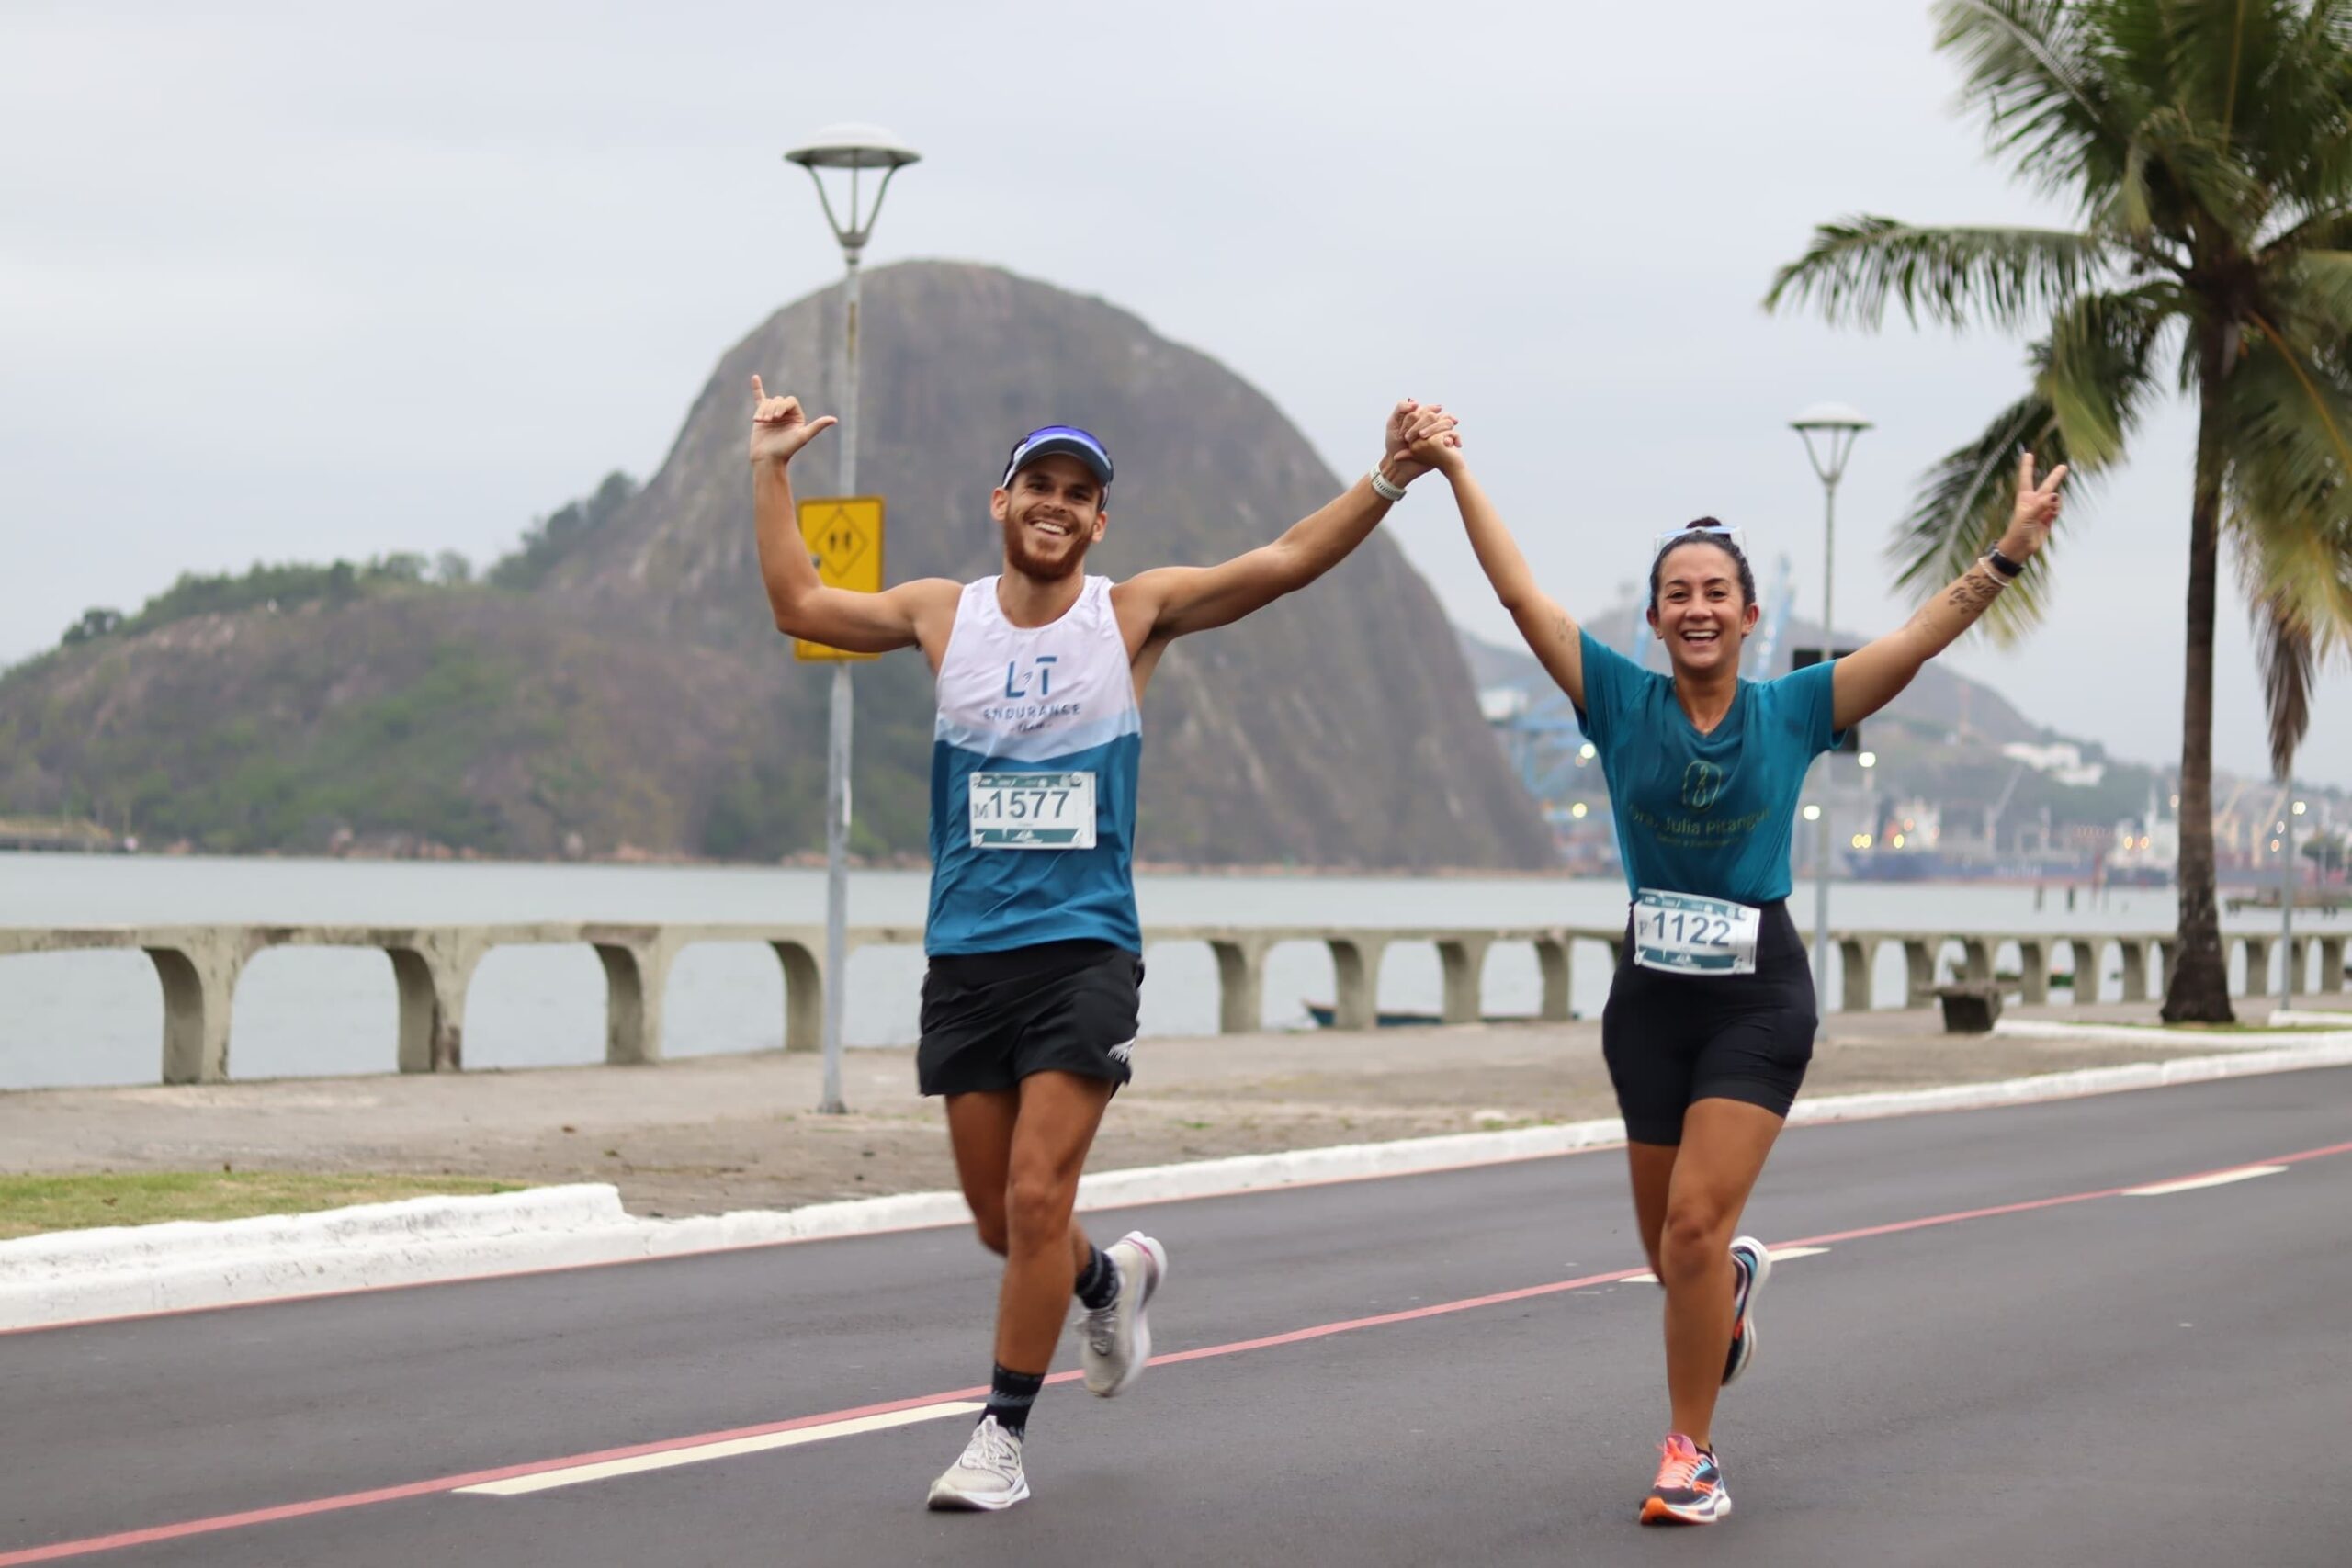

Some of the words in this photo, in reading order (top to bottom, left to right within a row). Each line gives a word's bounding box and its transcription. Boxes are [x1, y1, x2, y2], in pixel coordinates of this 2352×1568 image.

[983, 704, 1080, 721] ENDURANCE
[990, 790, 1069, 818] 1577
[1654, 911, 1731, 947] 1122
